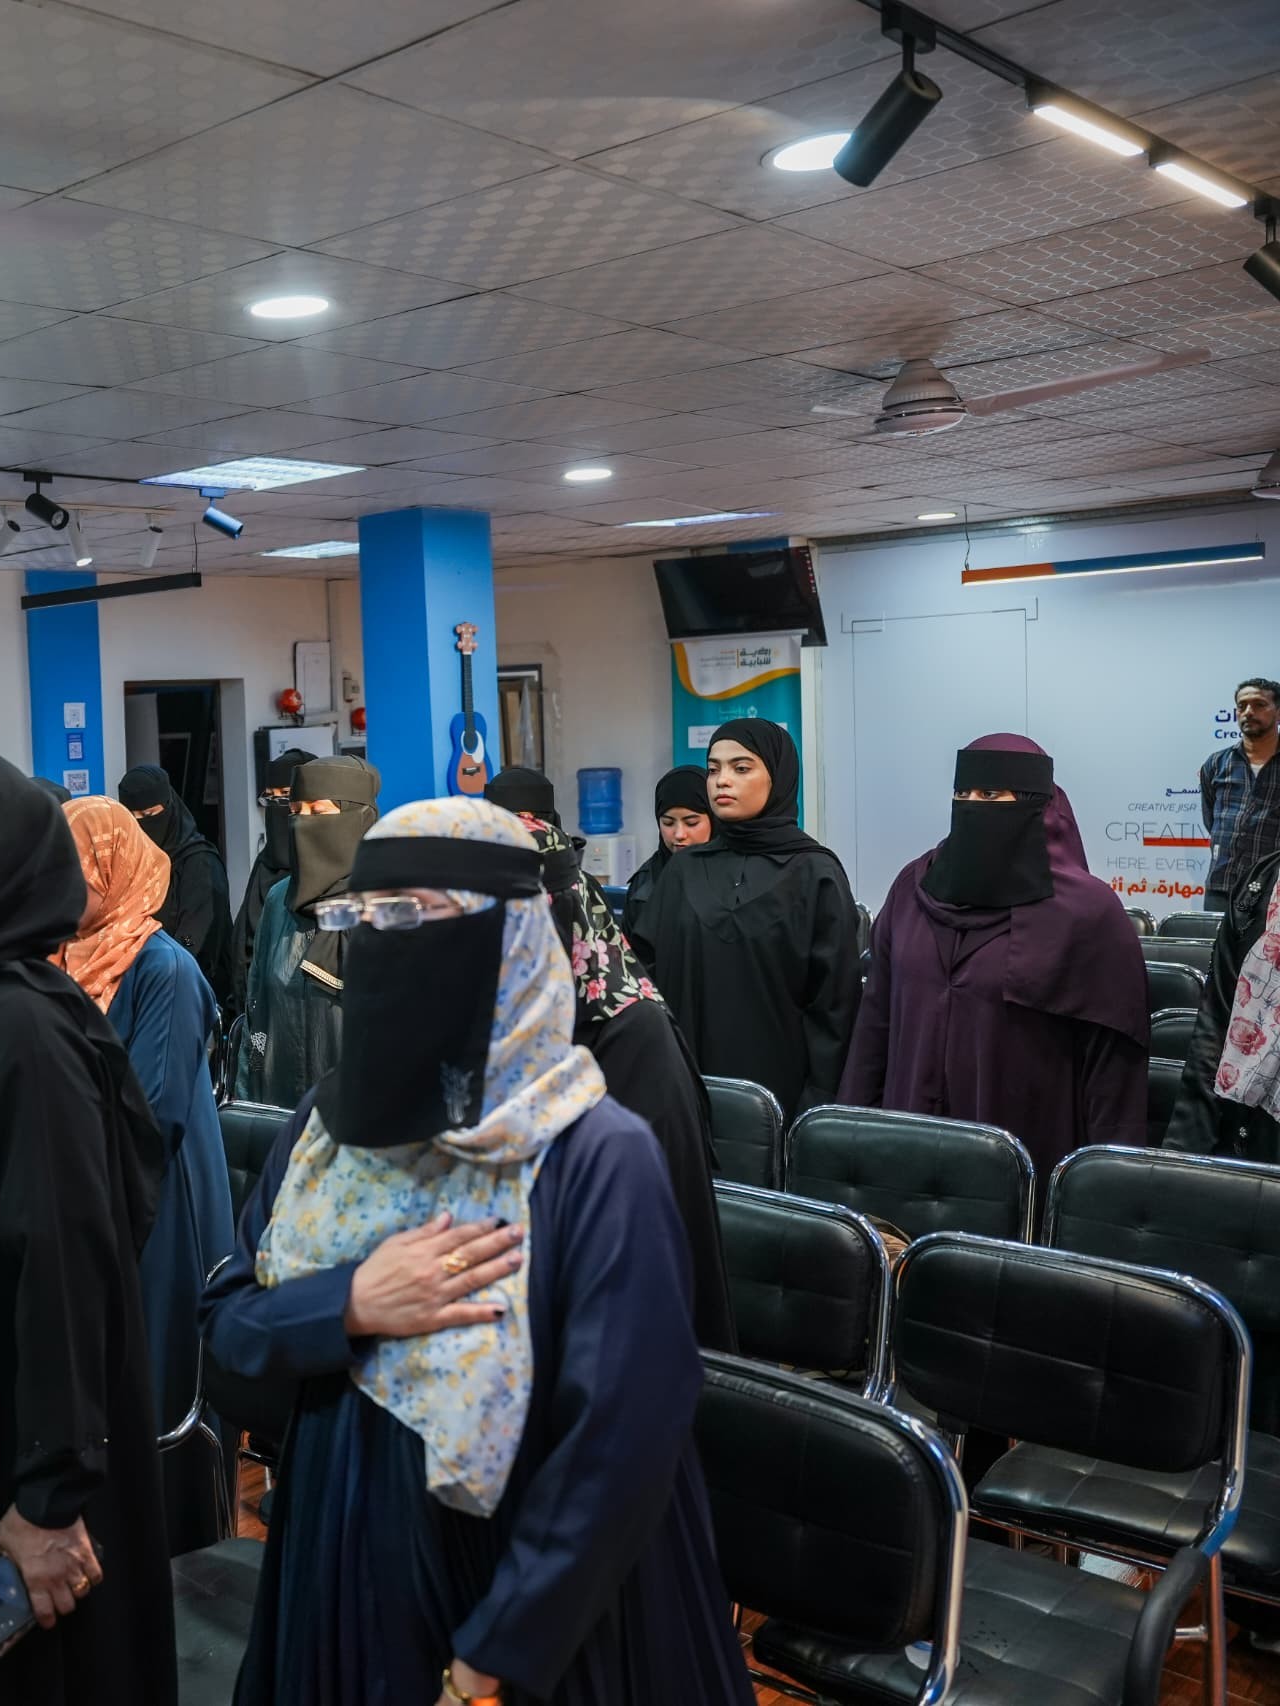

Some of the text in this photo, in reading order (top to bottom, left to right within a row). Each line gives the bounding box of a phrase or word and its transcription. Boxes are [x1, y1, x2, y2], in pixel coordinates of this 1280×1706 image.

[1215, 708, 1237, 722] ات
[1128, 803, 1176, 812] CREATIVE
[1105, 822, 1211, 842] CREATIV
[1155, 858, 1206, 871] EVERY
[1111, 876, 1124, 892] أث
[1127, 878, 1147, 896] ثم
